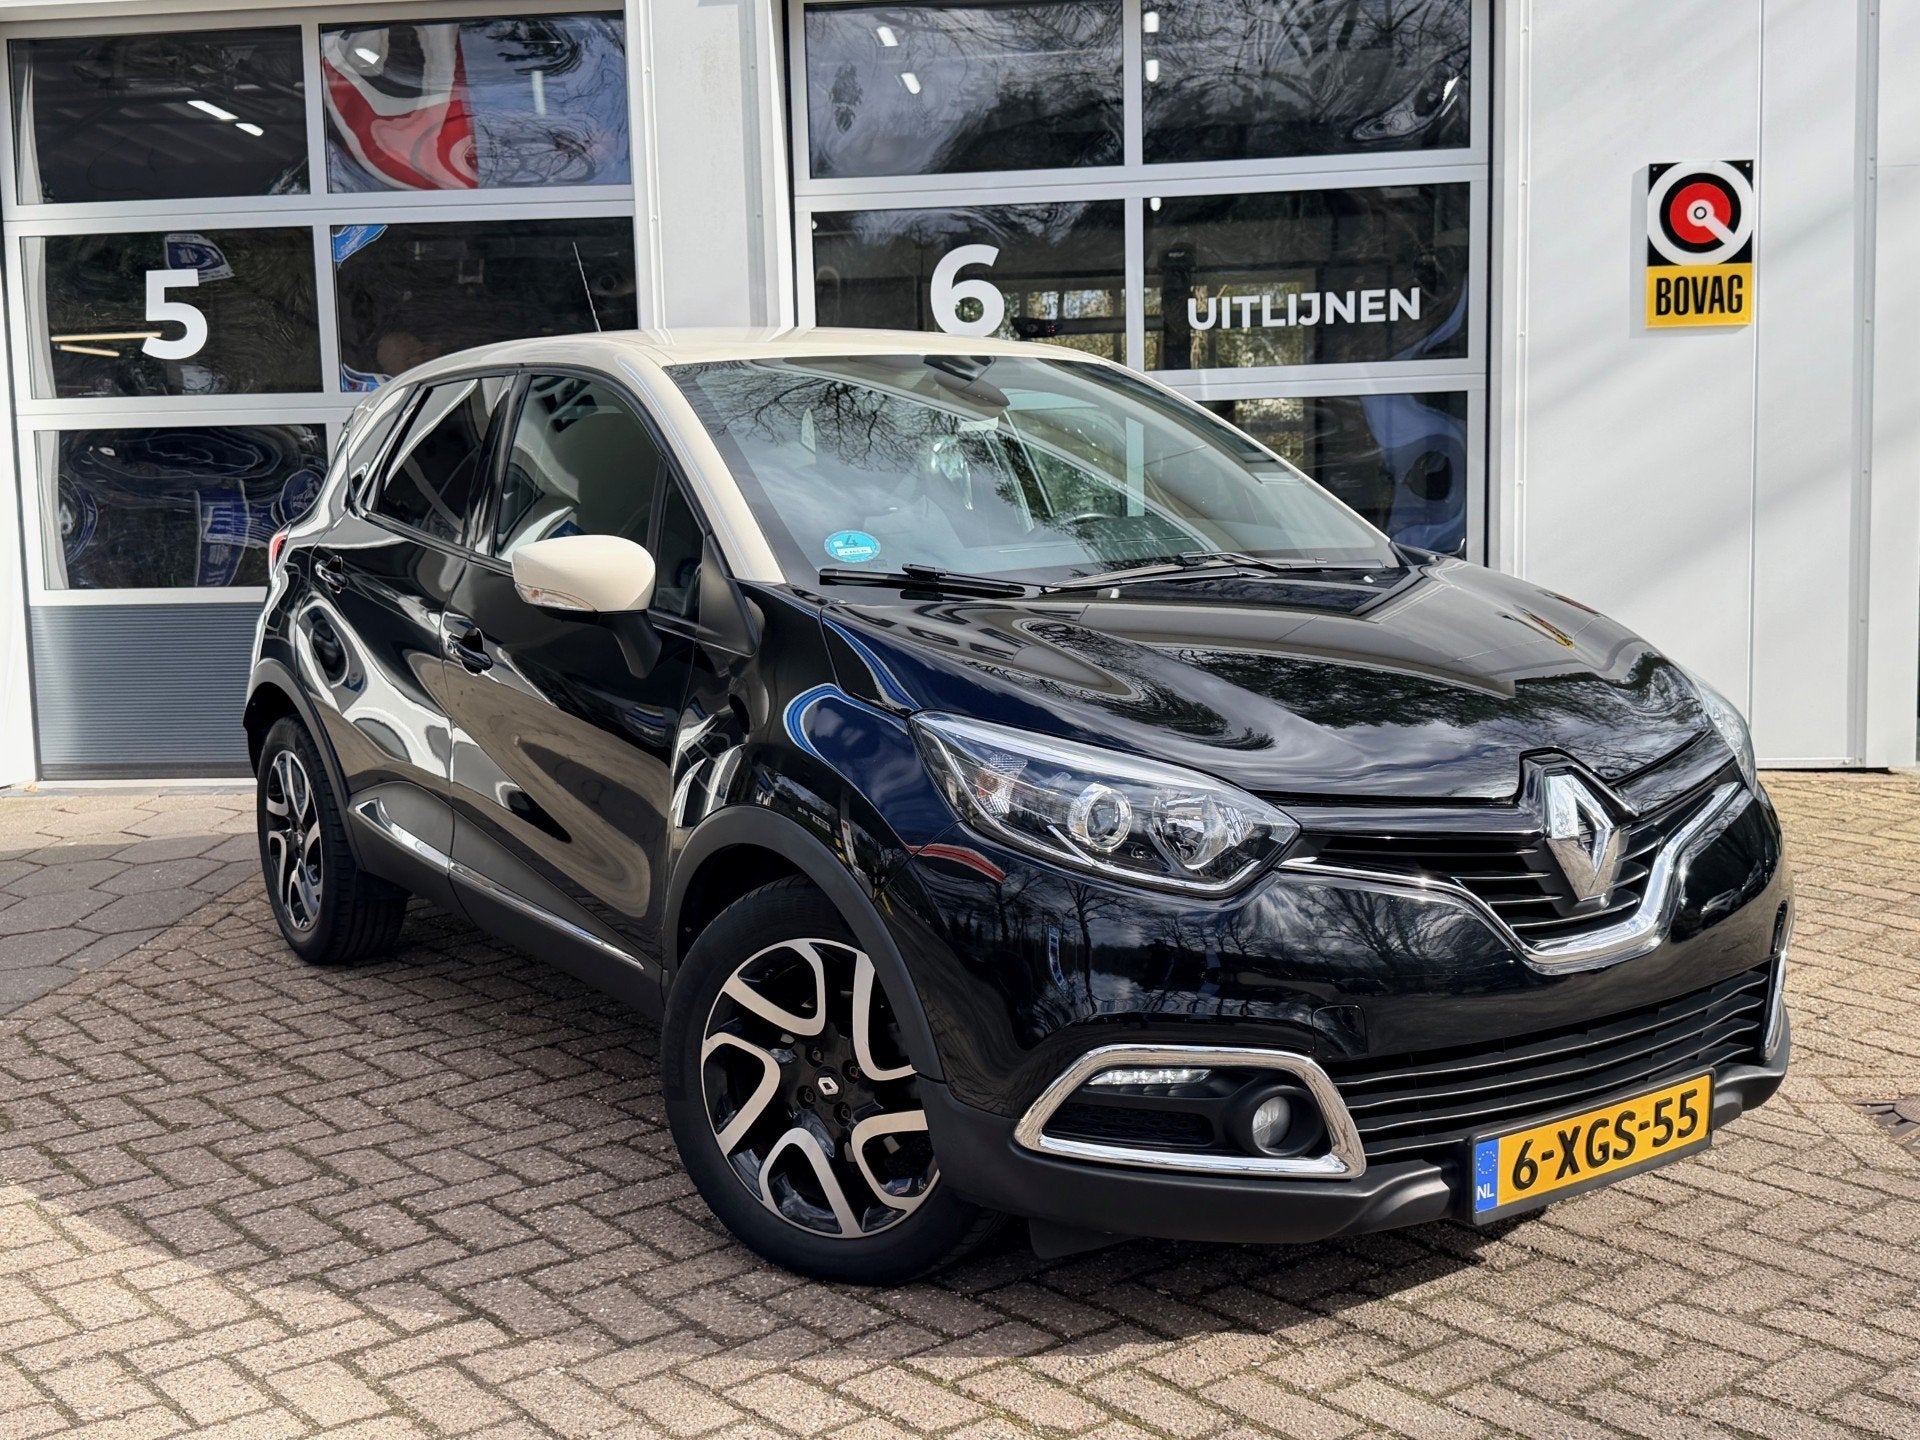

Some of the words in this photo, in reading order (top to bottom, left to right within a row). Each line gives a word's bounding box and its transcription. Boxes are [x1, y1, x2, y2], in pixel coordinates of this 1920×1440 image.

[142, 268, 208, 360] 5
[930, 243, 1005, 337] 6
[1187, 286, 1421, 331] UITLIJNEN
[1655, 274, 1744, 316] BOVAG
[1511, 1088, 1699, 1191] 6-XGS-55
[1477, 1181, 1495, 1201] NL
